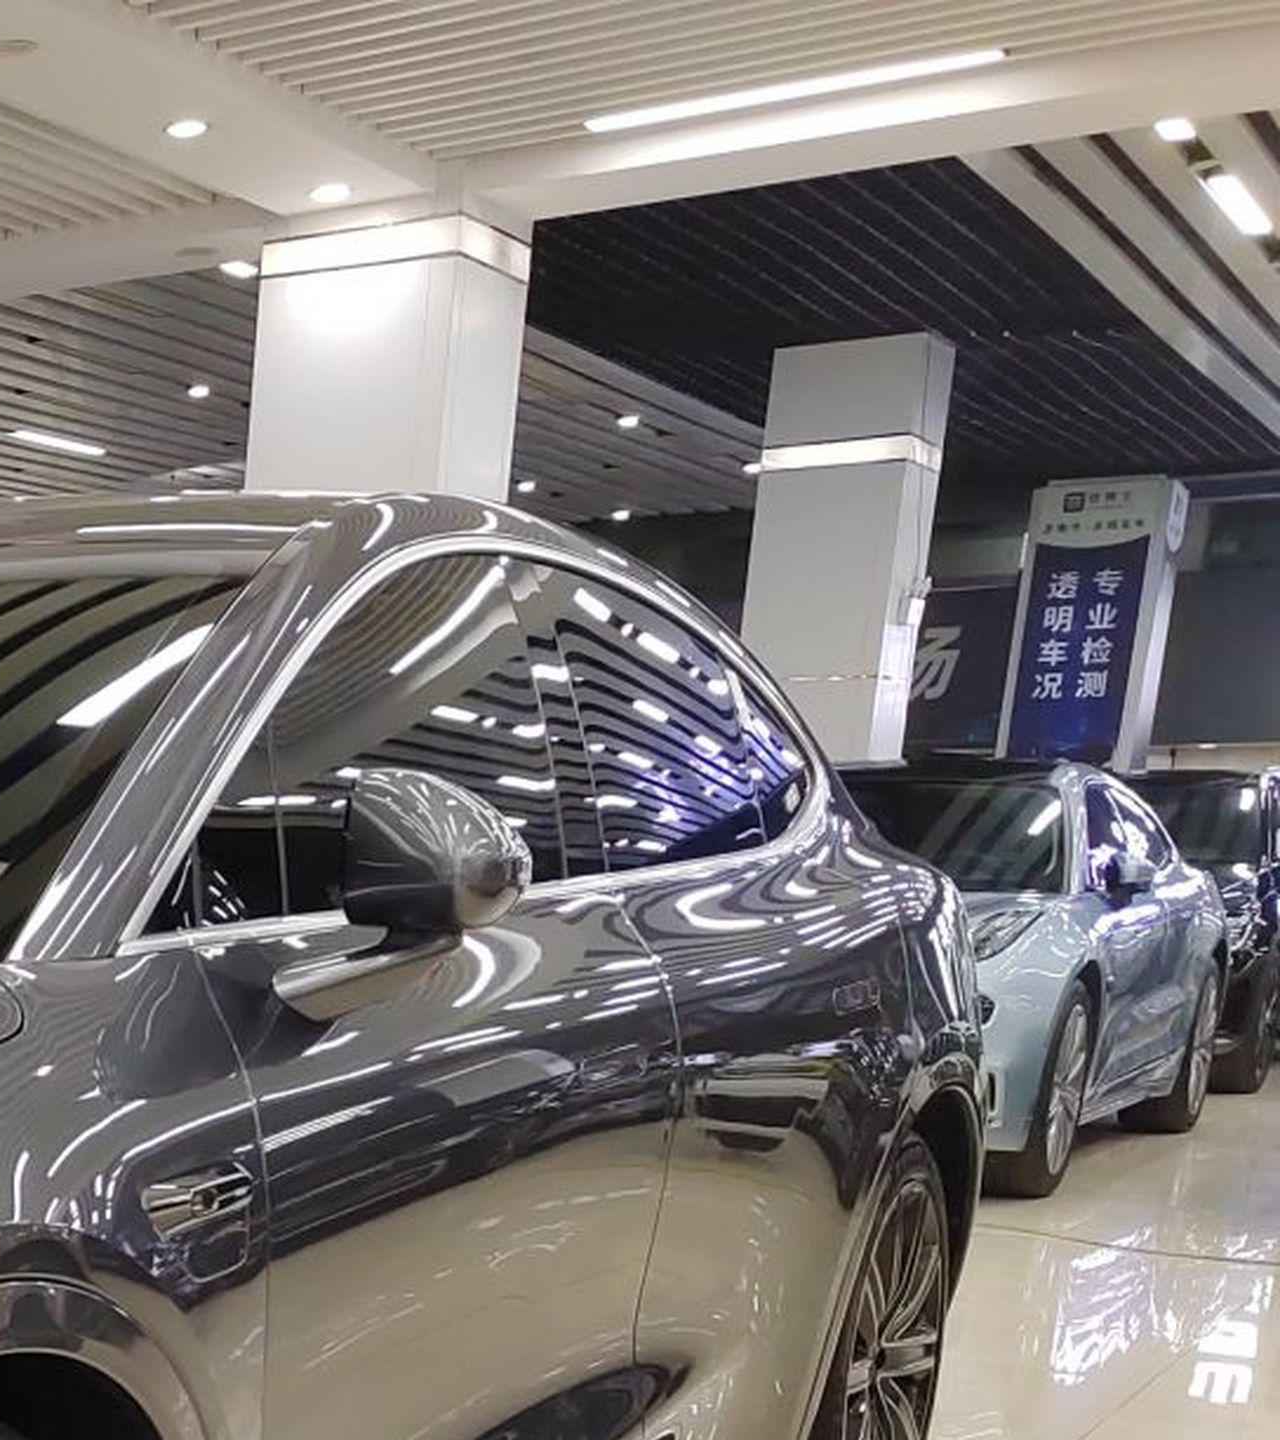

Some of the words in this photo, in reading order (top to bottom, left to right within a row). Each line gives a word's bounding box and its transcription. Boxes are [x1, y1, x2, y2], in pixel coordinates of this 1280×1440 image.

[1031, 571, 1081, 700] 透明车况
[1074, 568, 1124, 699] 专业检测
